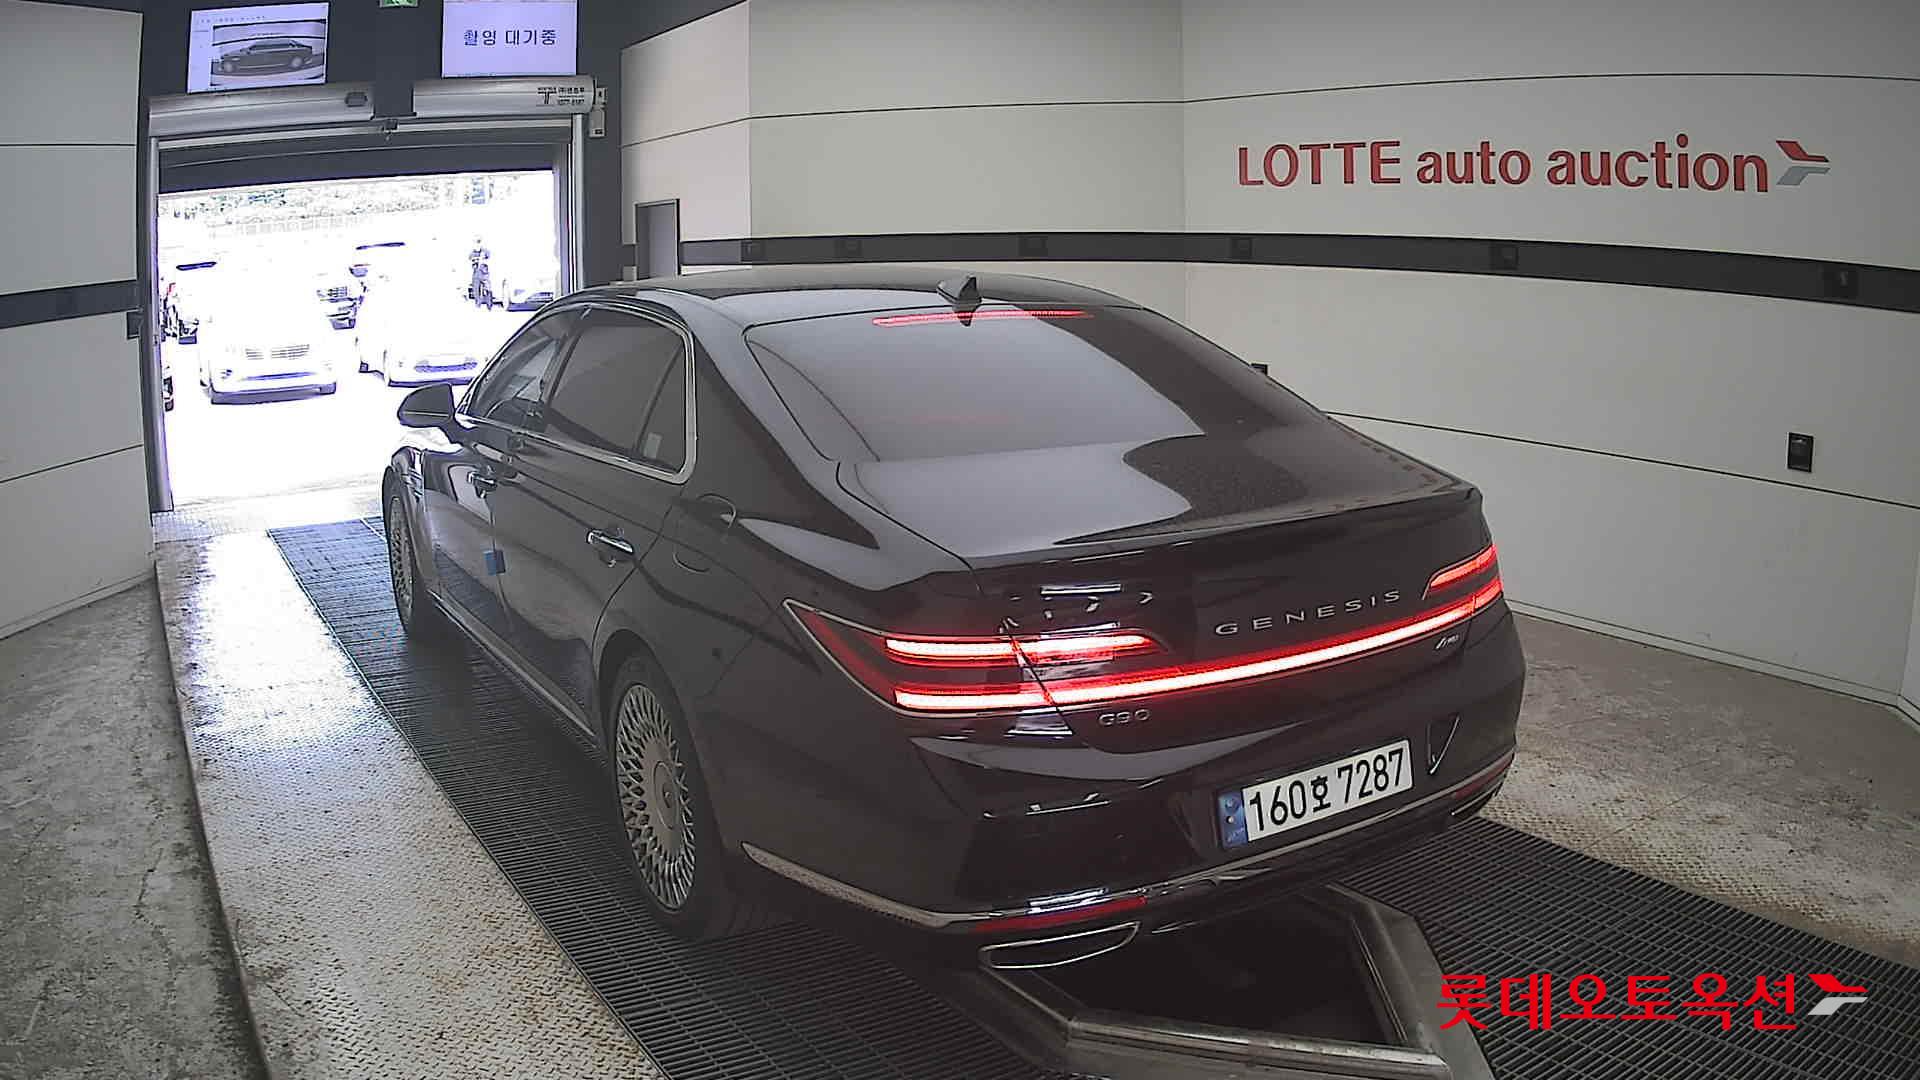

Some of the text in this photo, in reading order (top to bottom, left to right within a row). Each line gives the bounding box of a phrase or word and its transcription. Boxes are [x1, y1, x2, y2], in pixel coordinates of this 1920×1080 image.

[505, 29, 557, 46] 대기중
[1238, 133, 1769, 193] LOTTE auto auction
[1215, 590, 1401, 635] GENESIS
[1099, 709, 1149, 726] G90
[1249, 748, 1404, 831] 160호 7287
